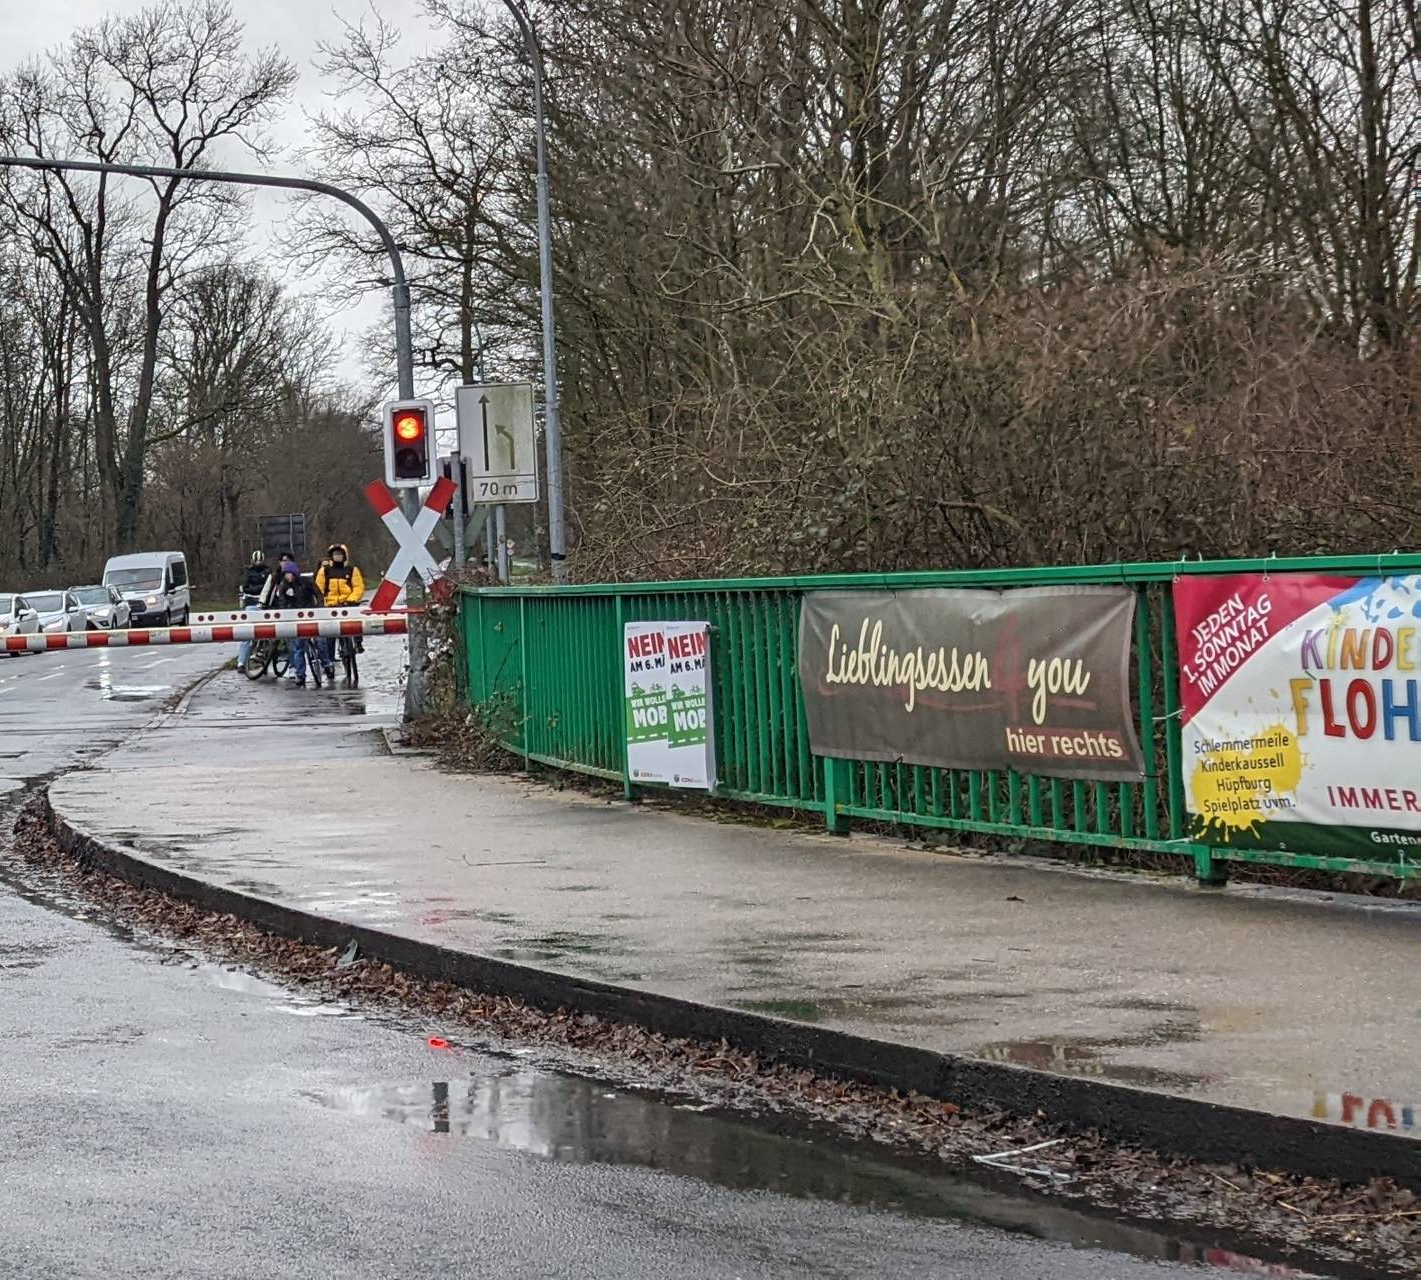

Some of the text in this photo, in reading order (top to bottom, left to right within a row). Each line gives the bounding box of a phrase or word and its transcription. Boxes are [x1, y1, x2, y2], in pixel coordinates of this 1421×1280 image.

[480, 482, 518, 497] 70 m
[1191, 592, 1245, 649] JEDEN
[667, 630, 707, 659] NEIN
[1183, 593, 1272, 684] 1. SONNTAG
[1300, 625, 1417, 671] KINDE
[630, 661, 644, 673] AM
[670, 662, 683, 675] AM
[1198, 616, 1269, 697] IM MONAT
[826, 617, 992, 712] Lieblingsessen
[1027, 657, 1090, 725] you
[633, 705, 668, 729] MOB
[1289, 678, 1421, 741] FLOH
[1005, 727, 1123, 758] hier rechts
[1194, 732, 1290, 754] Schlemmermeile
[1201, 753, 1284, 773] Kinderkaussell
[1217, 776, 1272, 795] Hüpfburg
[1326, 785, 1421, 812] IMMER
[1203, 797, 1296, 815] Spielplatz uvm.
